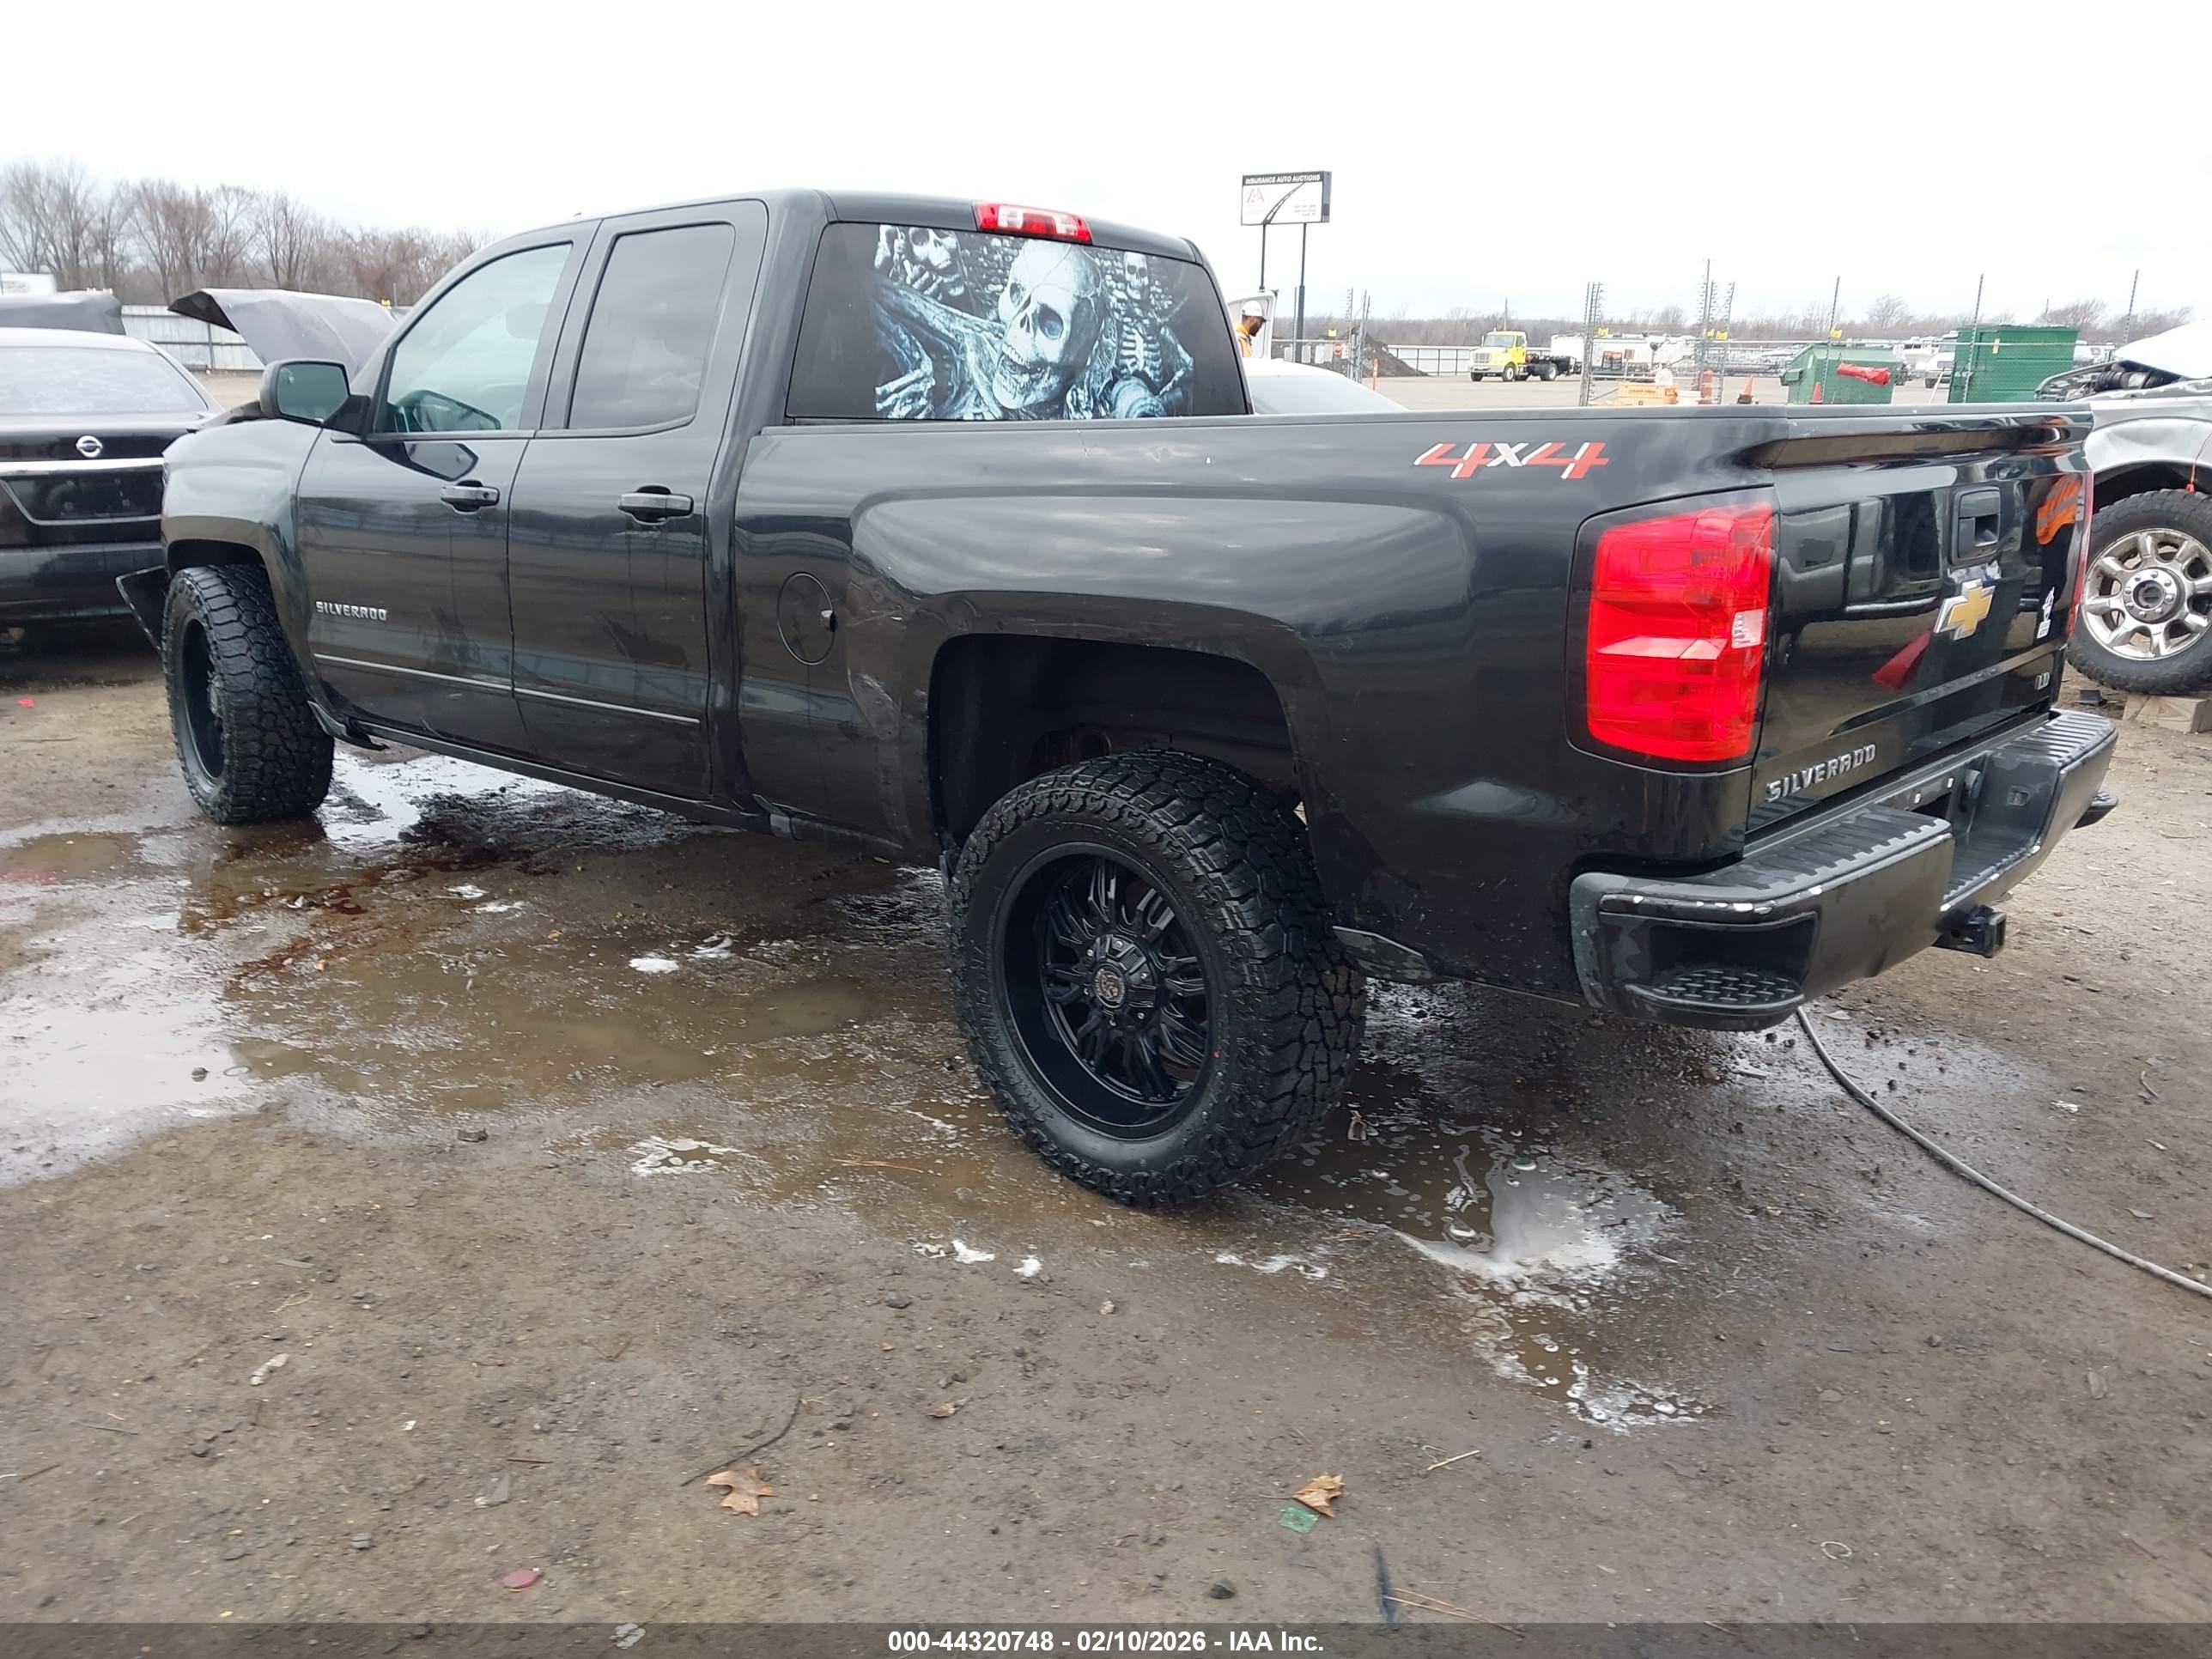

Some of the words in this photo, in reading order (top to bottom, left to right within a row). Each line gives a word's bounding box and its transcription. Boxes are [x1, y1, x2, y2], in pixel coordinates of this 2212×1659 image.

[1245, 176, 1276, 185] INSURANCE
[1291, 173, 1321, 183] AUCTIONS
[315, 601, 388, 621] SILVERADO
[1765, 744, 1876, 803] SILVERADO
